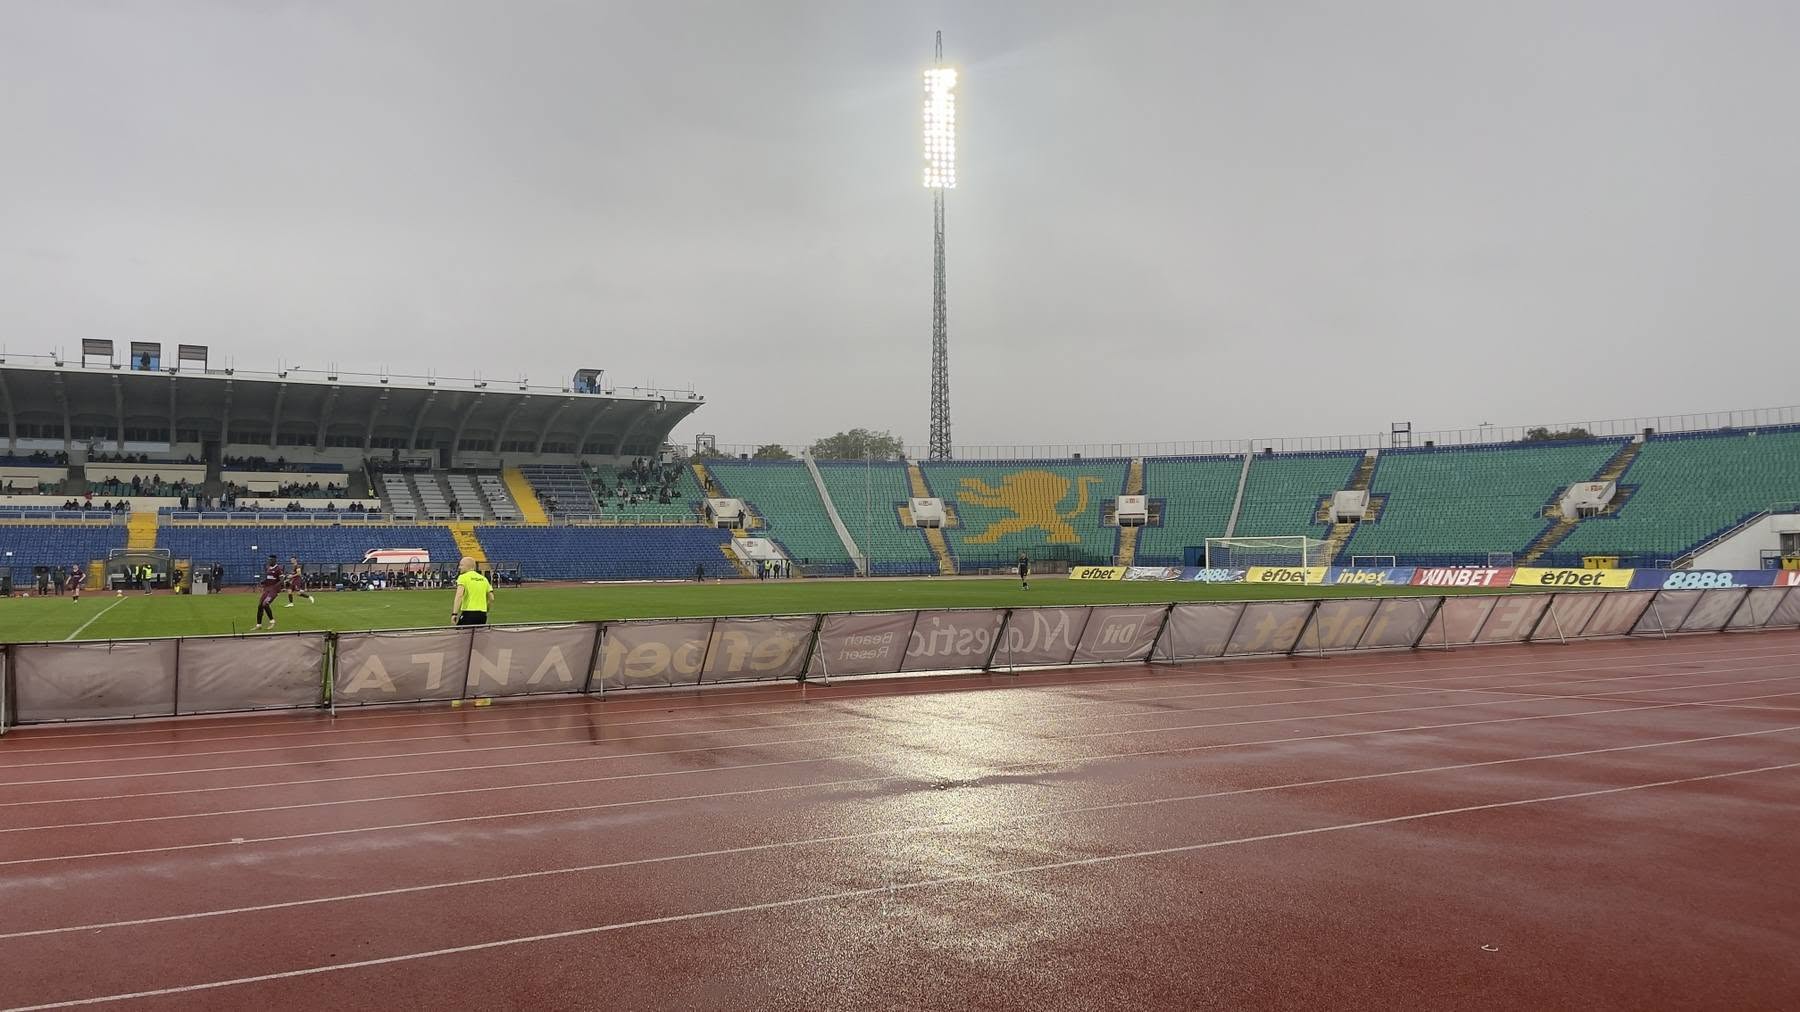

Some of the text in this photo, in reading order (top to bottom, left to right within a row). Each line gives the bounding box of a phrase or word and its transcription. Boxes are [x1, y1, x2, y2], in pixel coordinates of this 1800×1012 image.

[1081, 567, 1115, 579] efbet
[1420, 569, 1498, 586] WINBET
[1540, 570, 1605, 586] efbet
